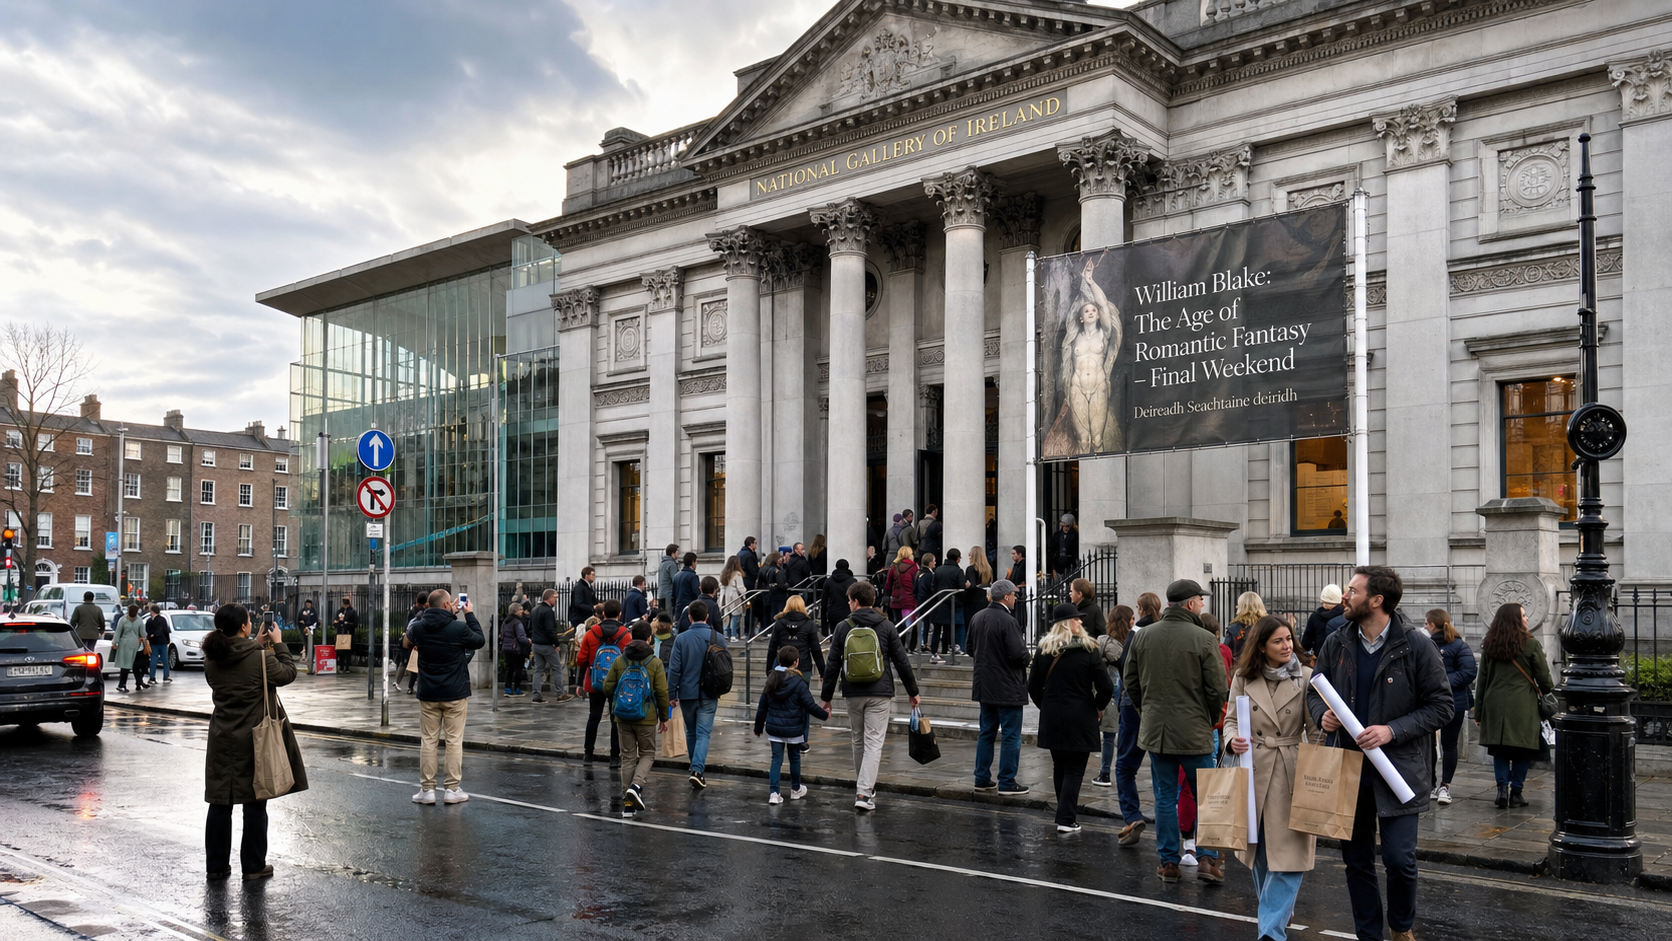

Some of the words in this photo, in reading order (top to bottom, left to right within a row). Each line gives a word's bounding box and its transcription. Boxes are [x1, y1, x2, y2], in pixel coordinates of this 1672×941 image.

[756, 159, 840, 195] NATIONAL
[846, 133, 928, 171] GALLERY
[932, 125, 959, 147] OF
[966, 97, 1062, 137] IRELAND
[1134, 280, 1207, 306] William
[1211, 266, 1272, 294] Blake:
[1134, 311, 1172, 335] The
[1175, 307, 1214, 332] Age
[1218, 297, 1241, 322] of
[1134, 332, 1228, 362] Romantic
[1232, 322, 1313, 348] Fantasy
[1150, 362, 1197, 388] Final
[1200, 347, 1296, 381] Weekend
[1133, 401, 1185, 419] Deireadh
[1186, 395, 1250, 414] Seachtaine
[1252, 387, 1298, 406] deiridh
